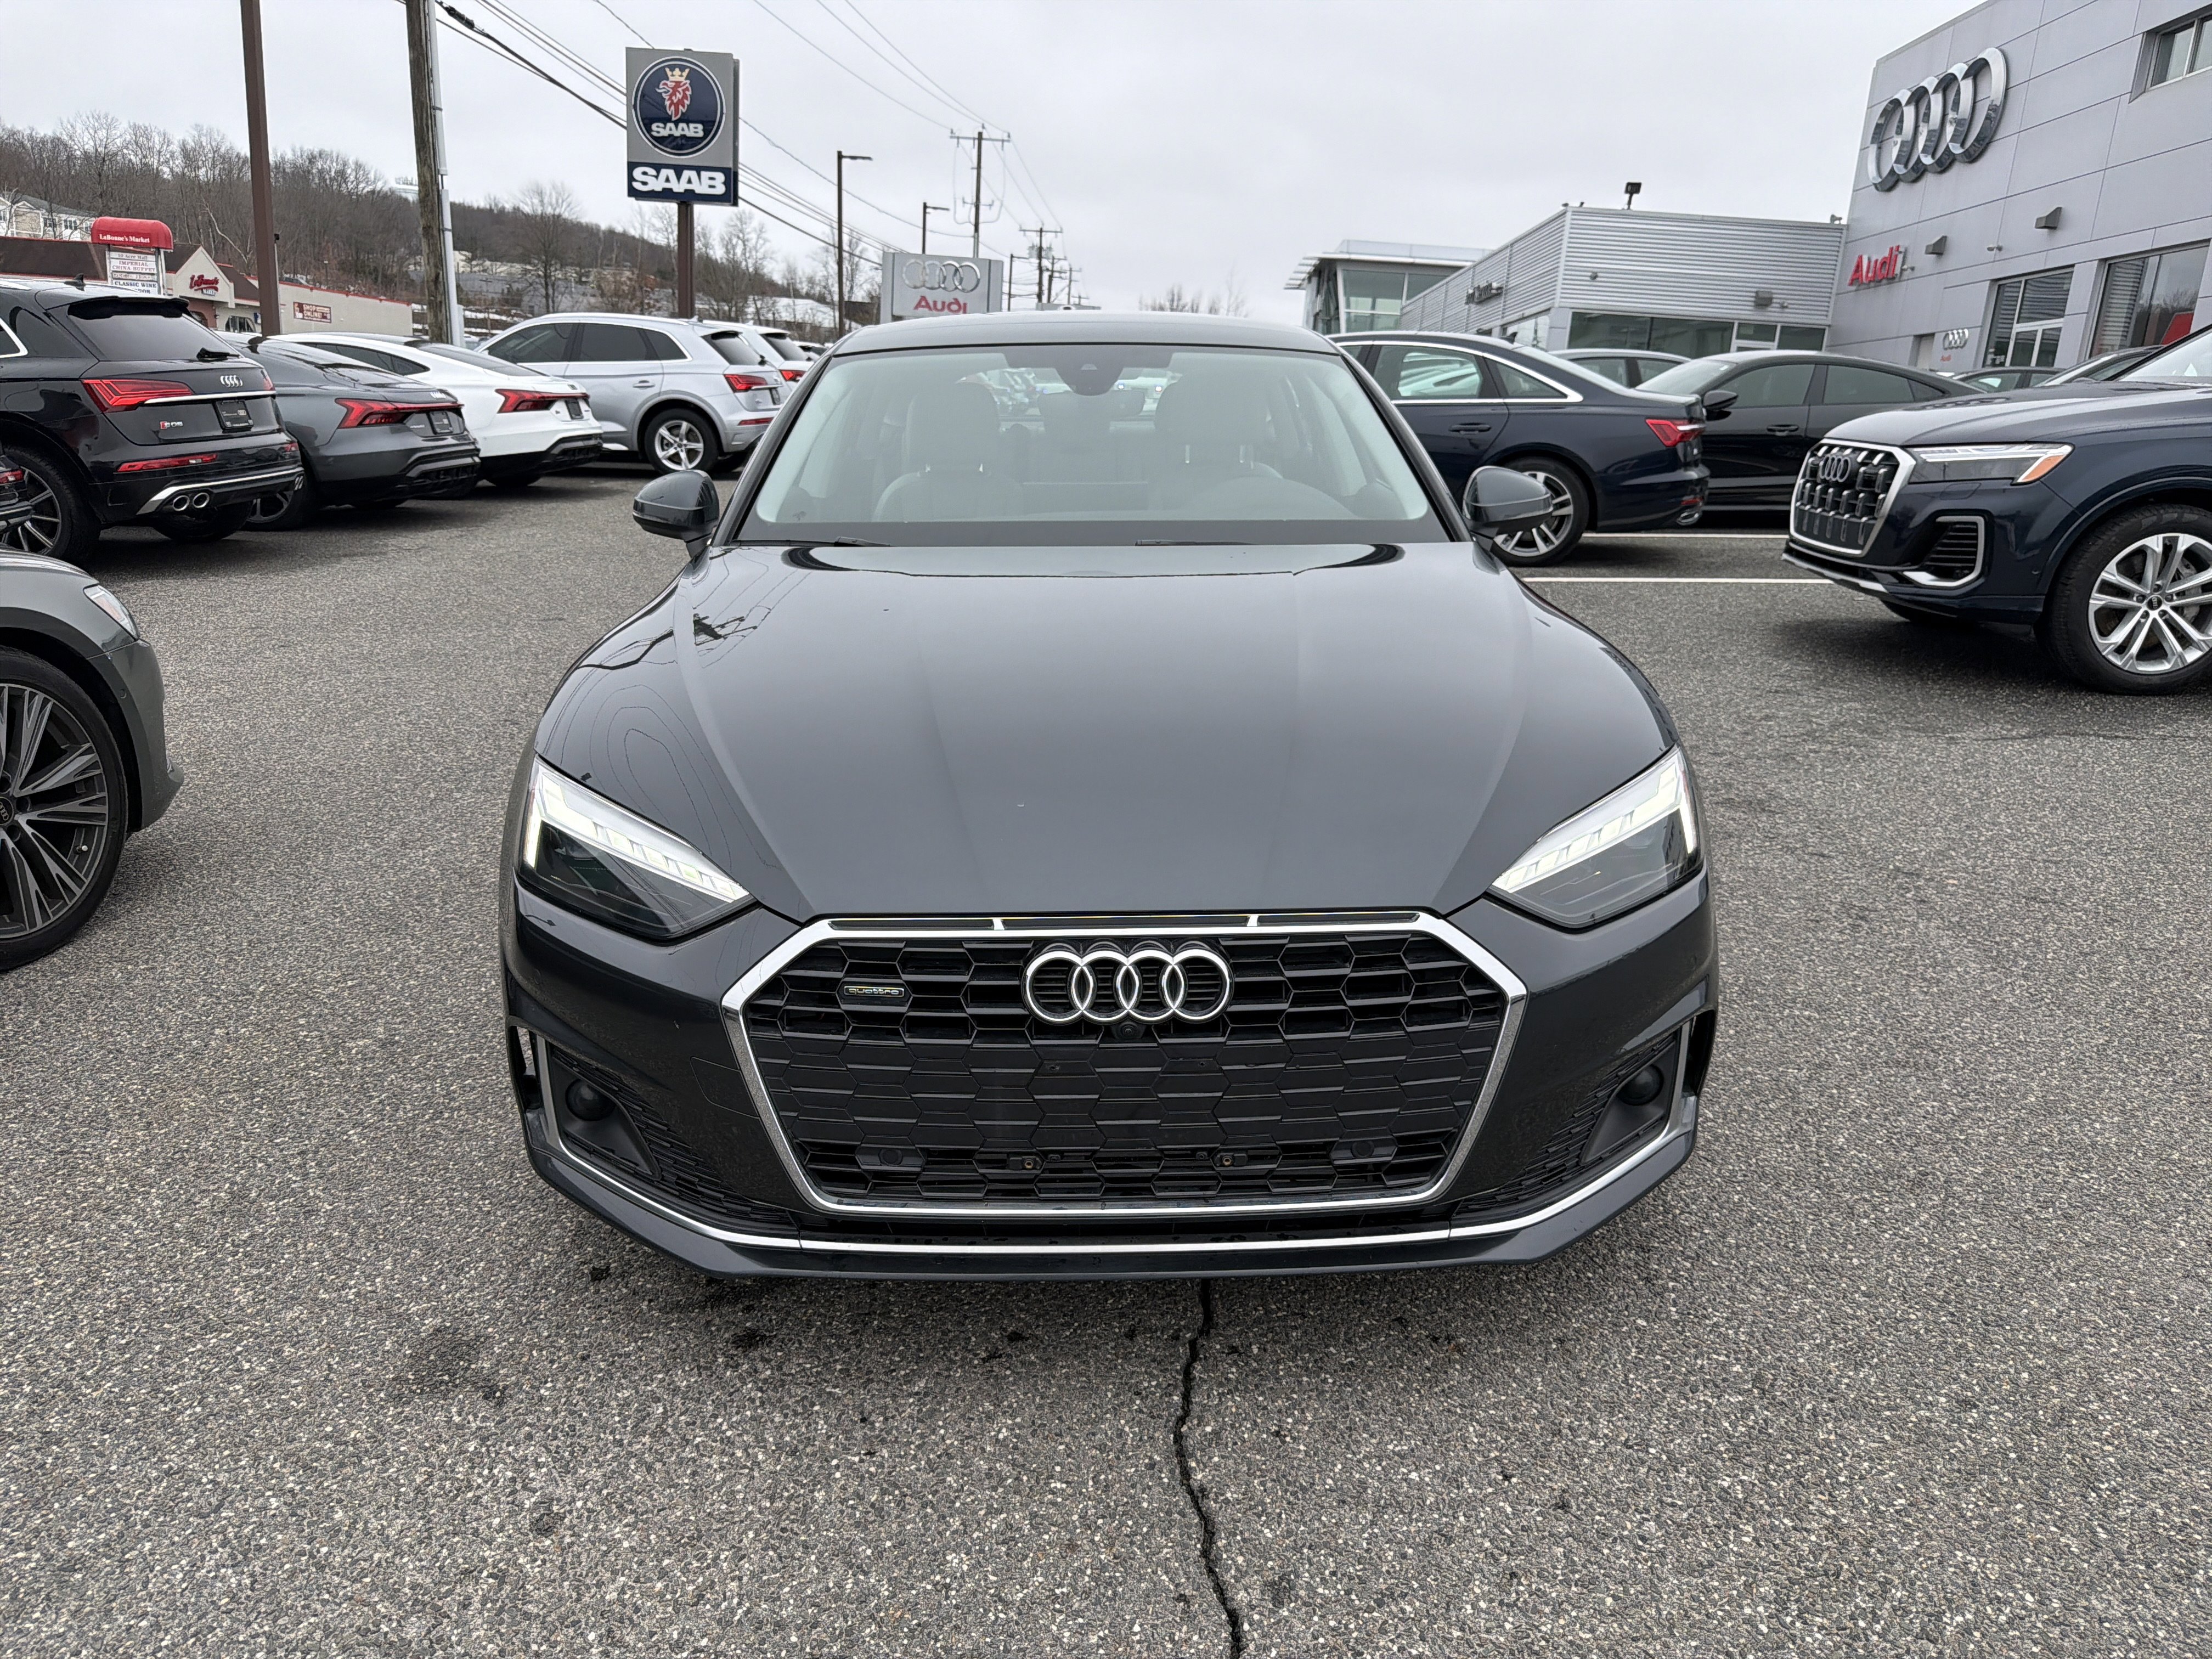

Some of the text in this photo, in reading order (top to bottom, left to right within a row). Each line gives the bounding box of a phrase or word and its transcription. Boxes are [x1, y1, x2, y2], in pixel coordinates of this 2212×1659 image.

[651, 122, 704, 137] SAAB
[631, 166, 725, 195] SAAB
[1848, 245, 1900, 286] Audi
[913, 295, 967, 314] Audi
